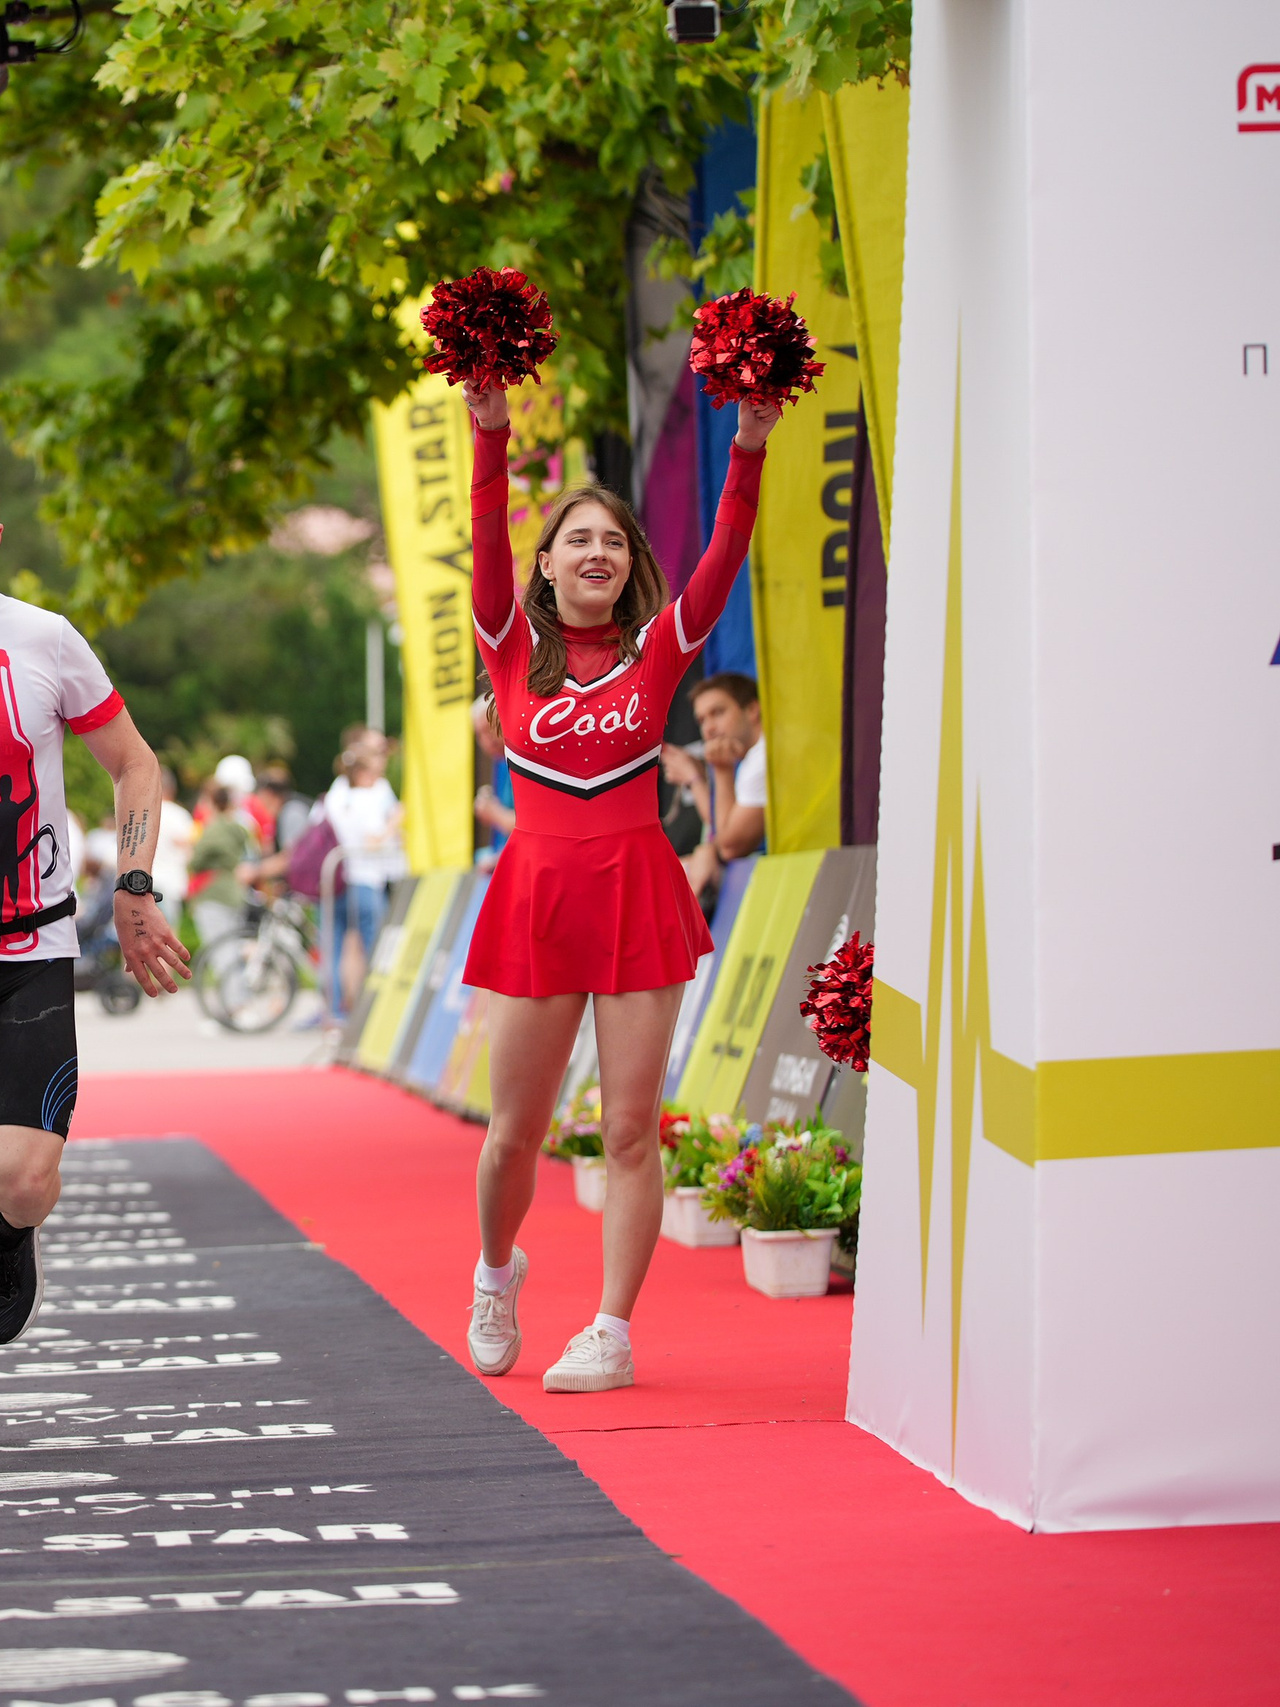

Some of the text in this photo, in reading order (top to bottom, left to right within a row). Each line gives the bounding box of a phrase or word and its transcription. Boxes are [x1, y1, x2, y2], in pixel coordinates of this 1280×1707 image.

[408, 398, 465, 709] IRON STAR
[529, 692, 642, 744] Cool
[15, 1352, 282, 1372] STAR
[28, 1423, 336, 1447] STAR
[42, 1523, 410, 1551] STAR
[53, 1582, 459, 1614] STAR
